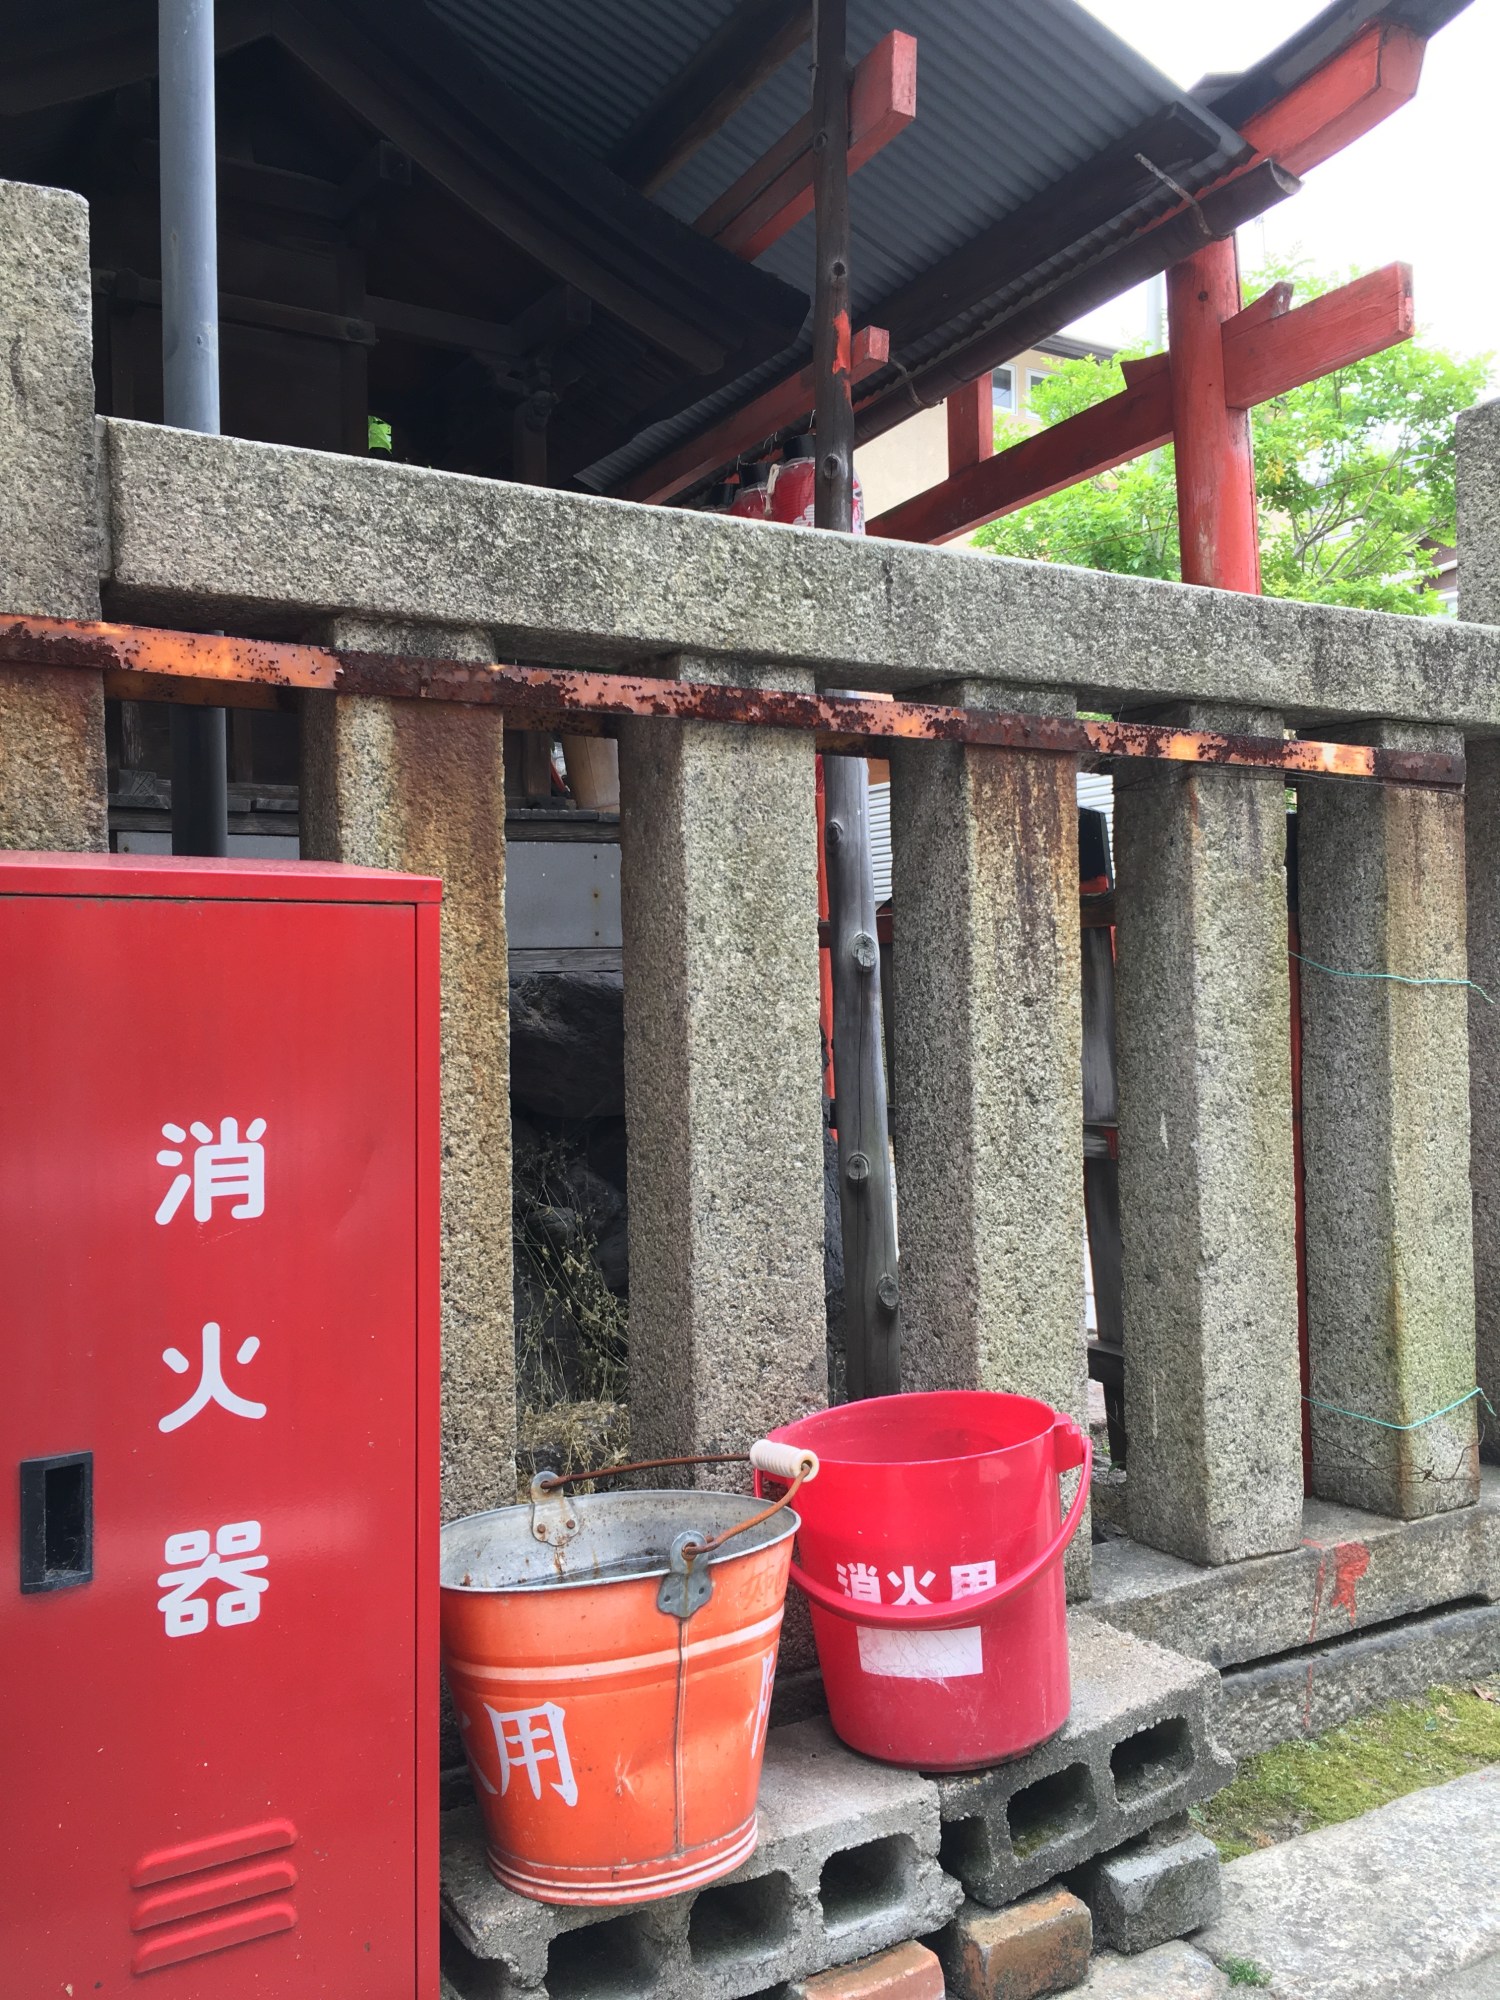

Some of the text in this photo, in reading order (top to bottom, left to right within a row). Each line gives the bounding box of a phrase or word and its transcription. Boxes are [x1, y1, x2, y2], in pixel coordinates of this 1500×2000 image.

[154, 1116, 270, 1638] 消火器
[836, 1559, 997, 1606] 消火用
